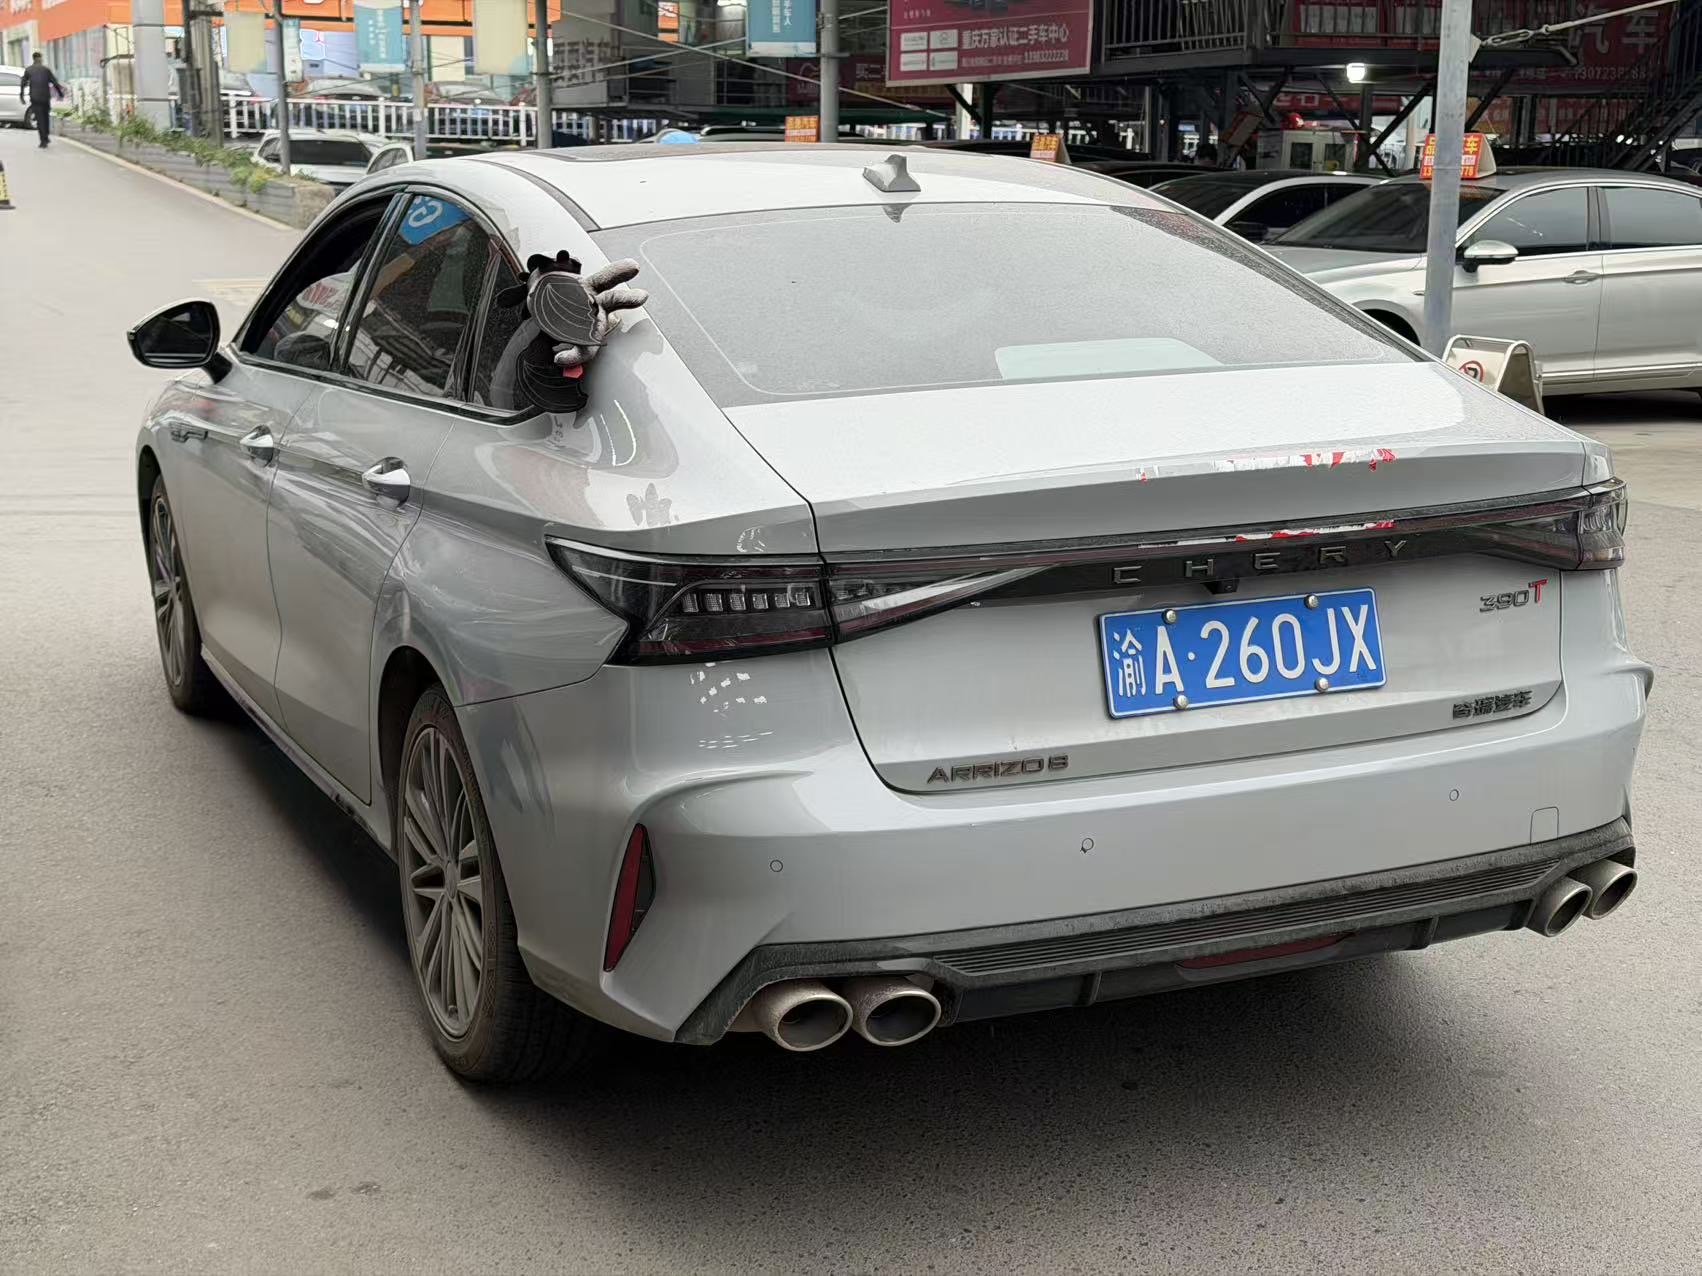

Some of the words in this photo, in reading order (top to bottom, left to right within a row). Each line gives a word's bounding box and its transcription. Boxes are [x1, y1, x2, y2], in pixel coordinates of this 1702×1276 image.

[961, 23, 1070, 50] 重庆万家认证二手车中心
[1113, 540, 1407, 585] CHERY
[1480, 578, 1549, 613] 390T
[926, 756, 1045, 785] ARRIZO
